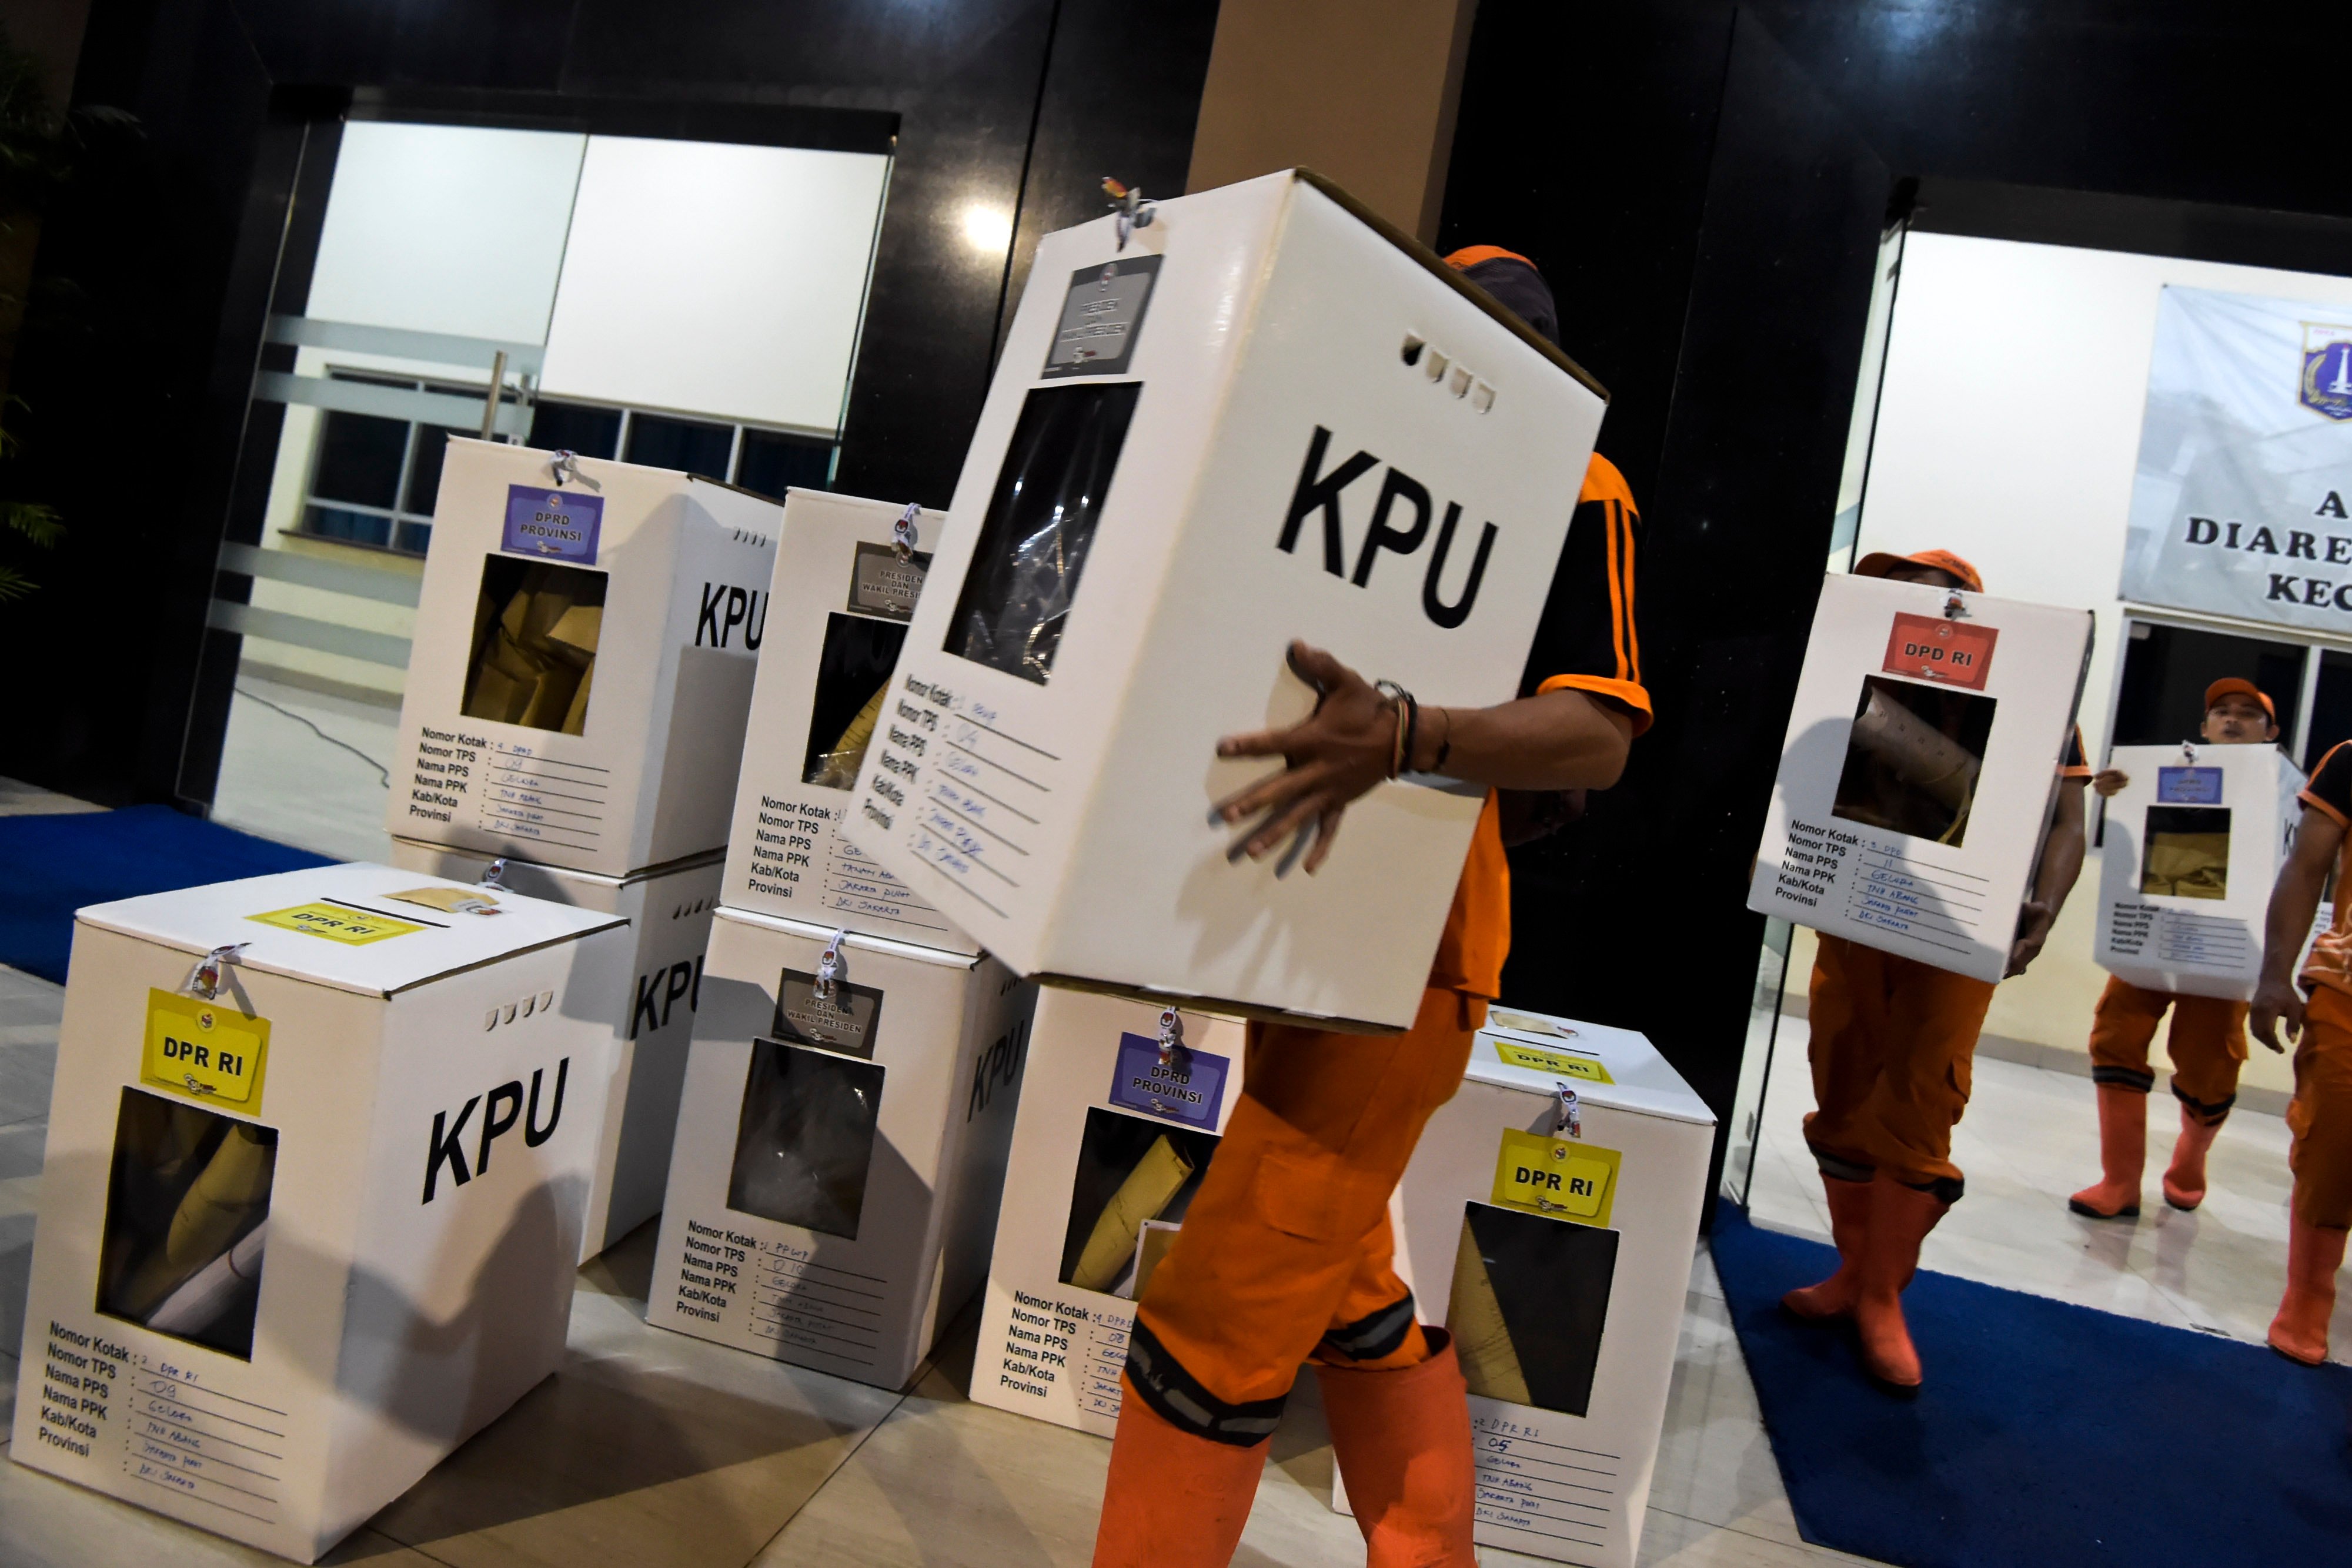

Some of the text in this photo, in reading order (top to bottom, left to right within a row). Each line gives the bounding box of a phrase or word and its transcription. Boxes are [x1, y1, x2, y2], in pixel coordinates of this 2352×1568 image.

[536, 512, 570, 525] DPRD
[1275, 424, 1499, 629] KPU
[520, 524, 582, 541] PROVINSI
[2186, 516, 2352, 565] DIARE
[880, 570, 923, 584] PRESIDEN
[891, 580, 908, 589] DAN
[863, 583, 921, 599] WAKIL PRESI
[2267, 573, 2352, 611] KEC
[695, 582, 769, 650] KPU
[1905, 643, 1973, 666] DPD RI
[422, 727, 487, 748] Nomor Kotak
[419, 742, 476, 762] Nomor TPS
[417, 758, 469, 777] Nama PPS
[415, 774, 467, 793] Nama PPK
[413, 790, 457, 807] Kab/Kota
[761, 795, 830, 820] Nomor Kotak
[410, 804, 451, 823] Provinsi
[759, 812, 818, 834] Nomor TPS
[756, 829, 811, 850] Nama PPS
[1791, 820, 1859, 845] Nomor Kotak
[753, 846, 809, 867] Nama PPK
[1788, 833, 1846, 857] Nomor TPS
[1785, 847, 1838, 870] Nama PPS
[751, 862, 799, 882] Kab/Kota
[1782, 860, 1835, 883] Nama PPK
[748, 879, 793, 898] Provinsi
[1779, 874, 1825, 894] Kab/Kota
[1775, 887, 1817, 907] Provinsi
[291, 913, 375, 934] DPR RI
[806, 999, 848, 1015] PRESIDEN
[817, 1009, 834, 1019] DAN
[788, 1011, 861, 1033] WAKIL PRESIDEN
[163, 1037, 242, 1076] DPR RI
[1518, 1054, 1589, 1072] DPR RI
[967, 1019, 1024, 1123] KPU
[1151, 1066, 1190, 1085] DPRD
[1132, 1077, 1202, 1104] PROVINSI
[422, 1057, 570, 1205] KPU
[1515, 1166, 1593, 1196] DPR RI
[689, 1220, 757, 1249] Nomor Kotak
[686, 1236, 745, 1262] Nomor TPS
[683, 1253, 738, 1277] Nama PPS
[681, 1269, 736, 1293] Nama PPK
[679, 1285, 727, 1308] Kab/Kota
[1014, 1290, 1089, 1320] Nomor Kotak
[676, 1301, 720, 1323] Provinsi
[1011, 1308, 1077, 1335] Nomor TPS
[50, 1320, 129, 1363] Nomor Kotak
[1008, 1325, 1068, 1350] Nama PPS
[48, 1342, 116, 1379] Nomor TPS
[1006, 1342, 1066, 1368] Nama PPK
[45, 1363, 108, 1398] Nama PPS
[1003, 1358, 1055, 1382] Kab/Kota
[1000, 1375, 1048, 1397] Provinsi
[43, 1385, 107, 1420] Nama PPK
[41, 1406, 96, 1438] Kab/Kota
[1491, 1419, 1517, 1433] DPR
[38, 1427, 89, 1457] Provinsi
[1488, 1437, 1512, 1452] 05
